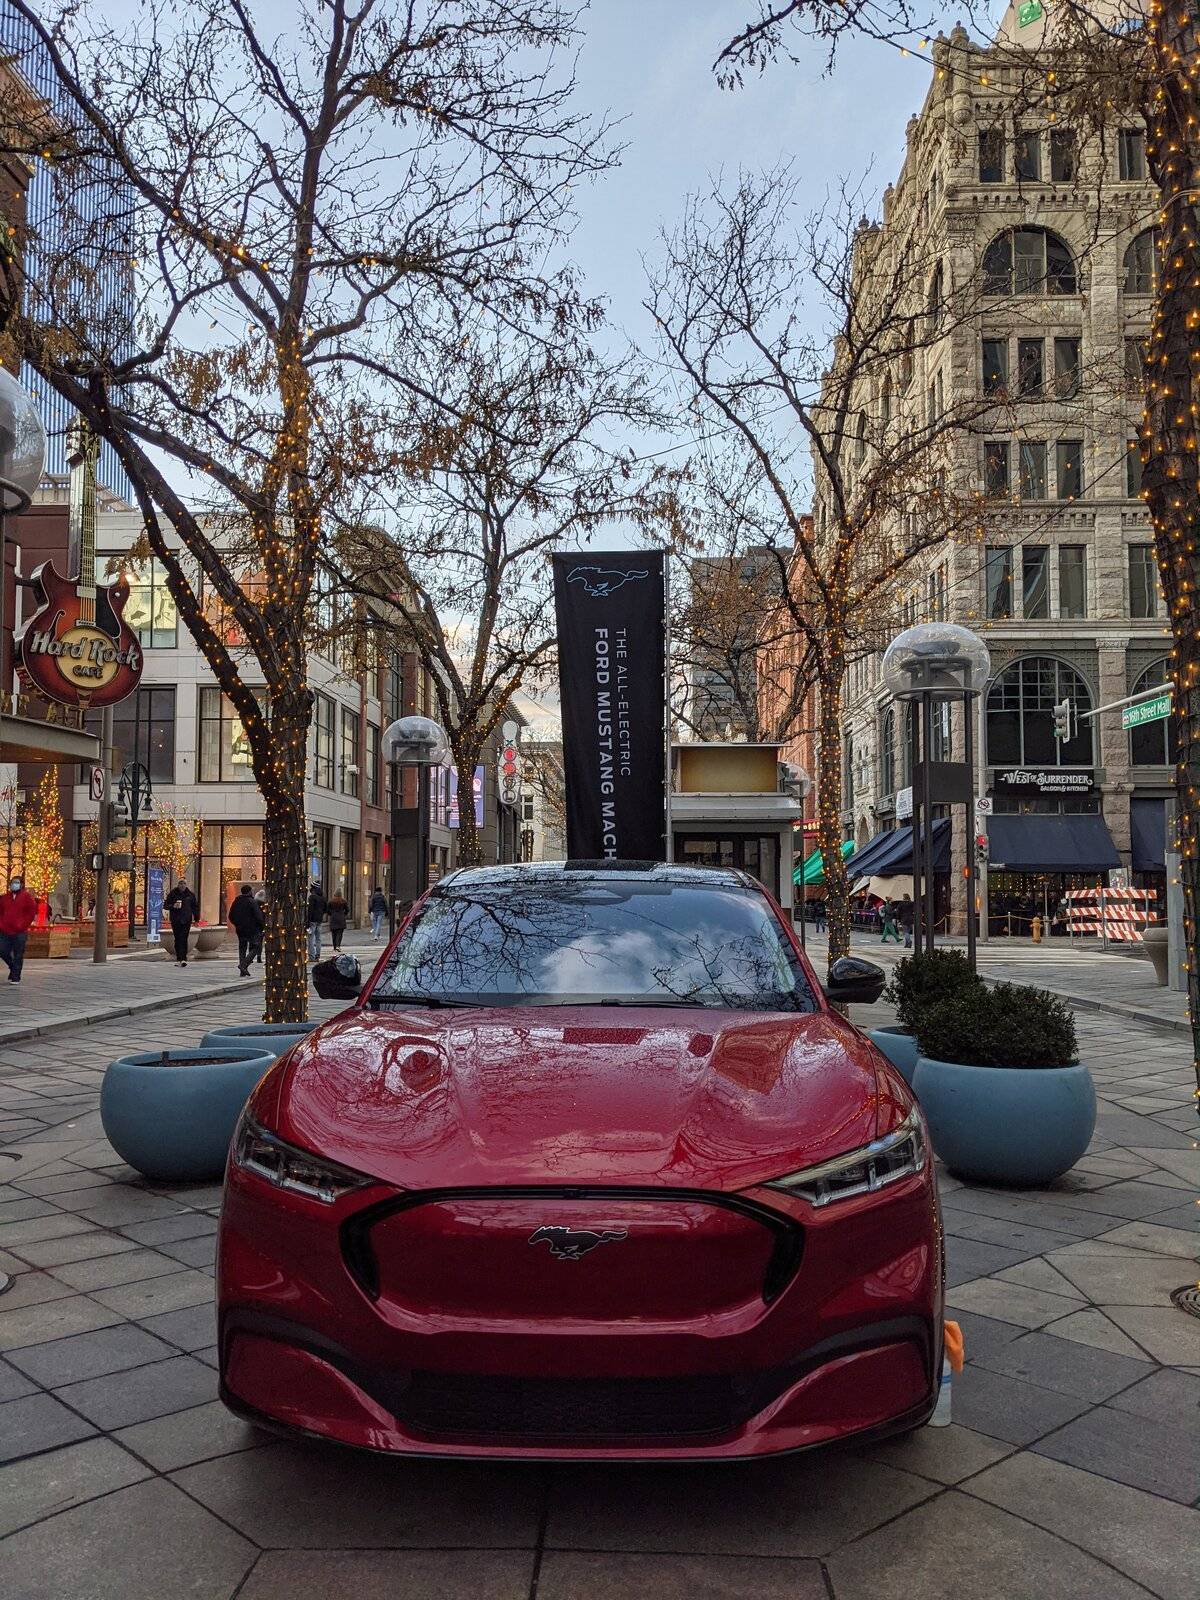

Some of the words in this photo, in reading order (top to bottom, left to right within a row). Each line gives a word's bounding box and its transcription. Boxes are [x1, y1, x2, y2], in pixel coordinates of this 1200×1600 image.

[30, 630, 88, 658] Hard
[89, 637, 140, 671] Rock
[595, 628, 610, 684] FORD
[615, 628, 627, 658] THE
[617, 665, 631, 777] ALL-ELECTRIC
[1129, 710, 1139, 723] 16th
[1140, 704, 1156, 720] Street
[1157, 698, 1169, 715] Mall
[596, 692, 614, 795] MUSTANG
[1004, 770, 1031, 784] WEST
[1036, 772, 1093, 785] SURRENDER
[601, 802, 617, 862] MACH
